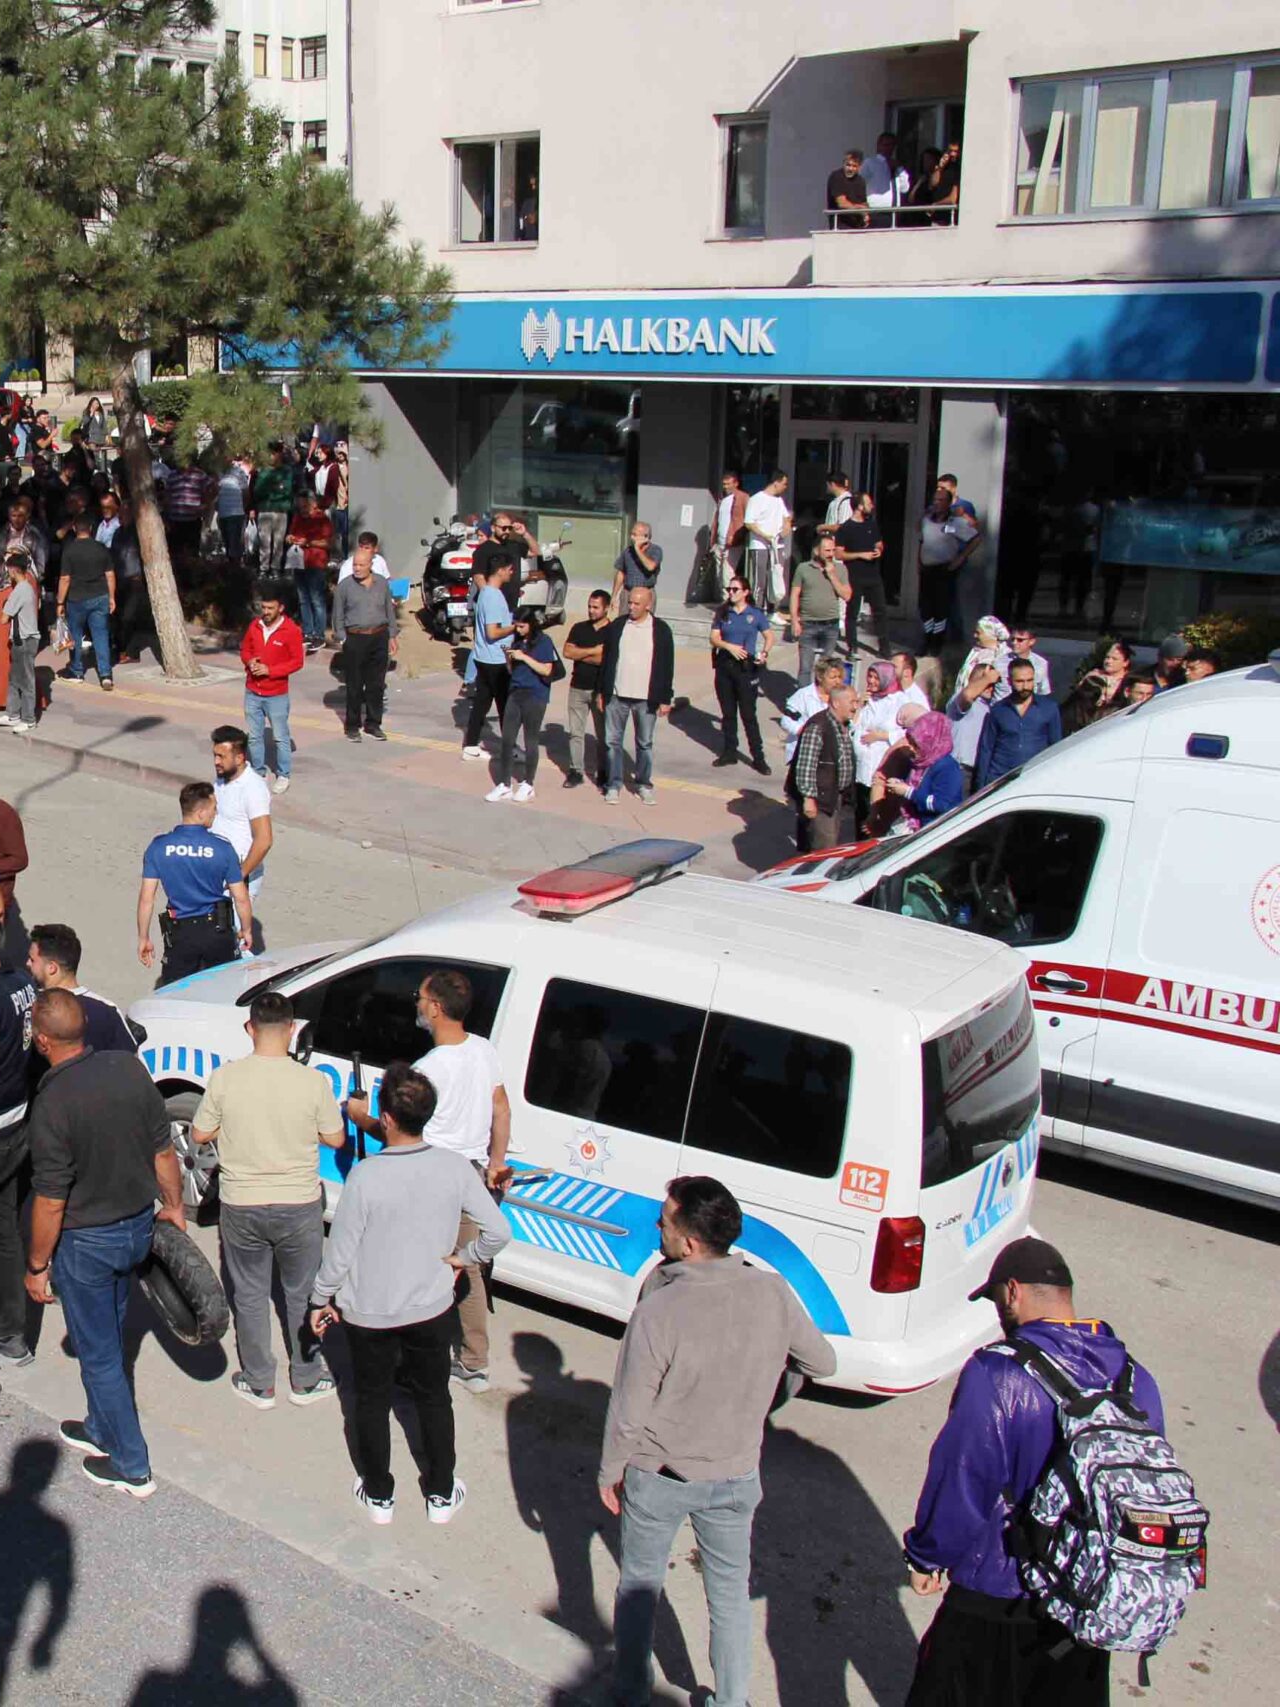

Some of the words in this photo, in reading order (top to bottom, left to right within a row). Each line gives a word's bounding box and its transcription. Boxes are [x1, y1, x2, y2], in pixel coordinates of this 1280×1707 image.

[564, 317, 779, 354] HALKBANK
[1135, 976, 1280, 1034] AMBU
[850, 1167, 882, 1194] 112
[1117, 1539, 1161, 1556] COACH
